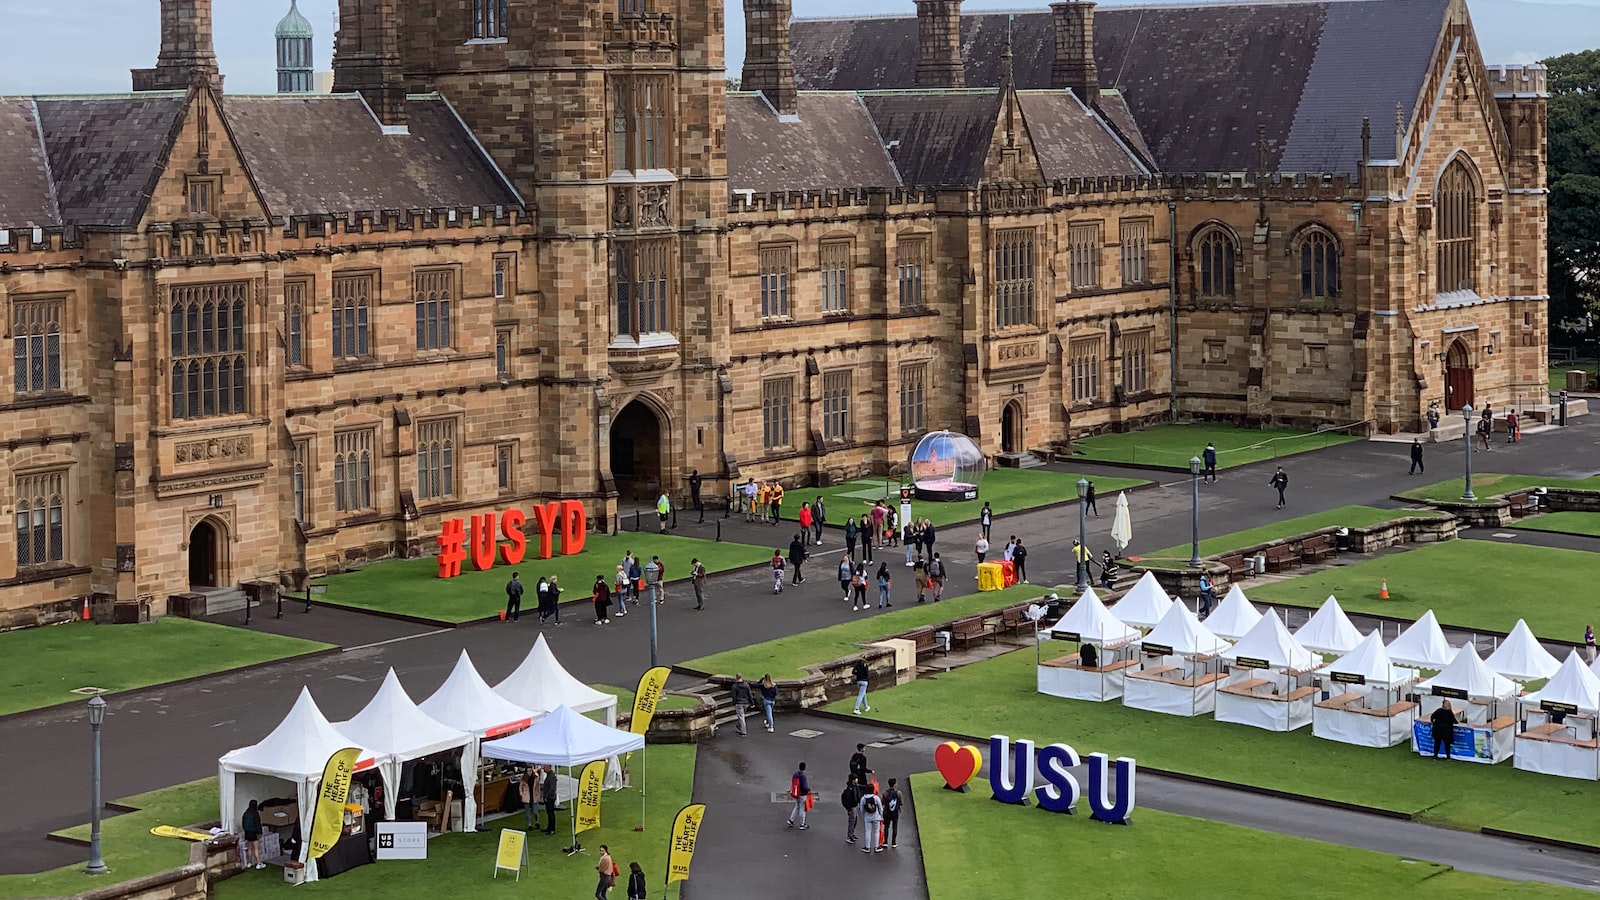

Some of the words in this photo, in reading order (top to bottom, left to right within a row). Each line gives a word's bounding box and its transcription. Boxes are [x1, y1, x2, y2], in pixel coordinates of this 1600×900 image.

[436, 499, 586, 578] #USYD
[640, 687, 652, 712] HEART
[649, 676, 656, 687] OF
[650, 685, 659, 700] LIFE
[331, 773, 342, 802] HEART
[338, 760, 345, 771] OF
[341, 768, 350, 786] LIFE
[590, 770, 595, 780] OF
[990, 734, 1136, 823] USU
[324, 782, 333, 798] THE
[337, 788, 346, 803] UNI
[682, 826, 690, 852] HEART
[686, 814, 692, 824] OF
